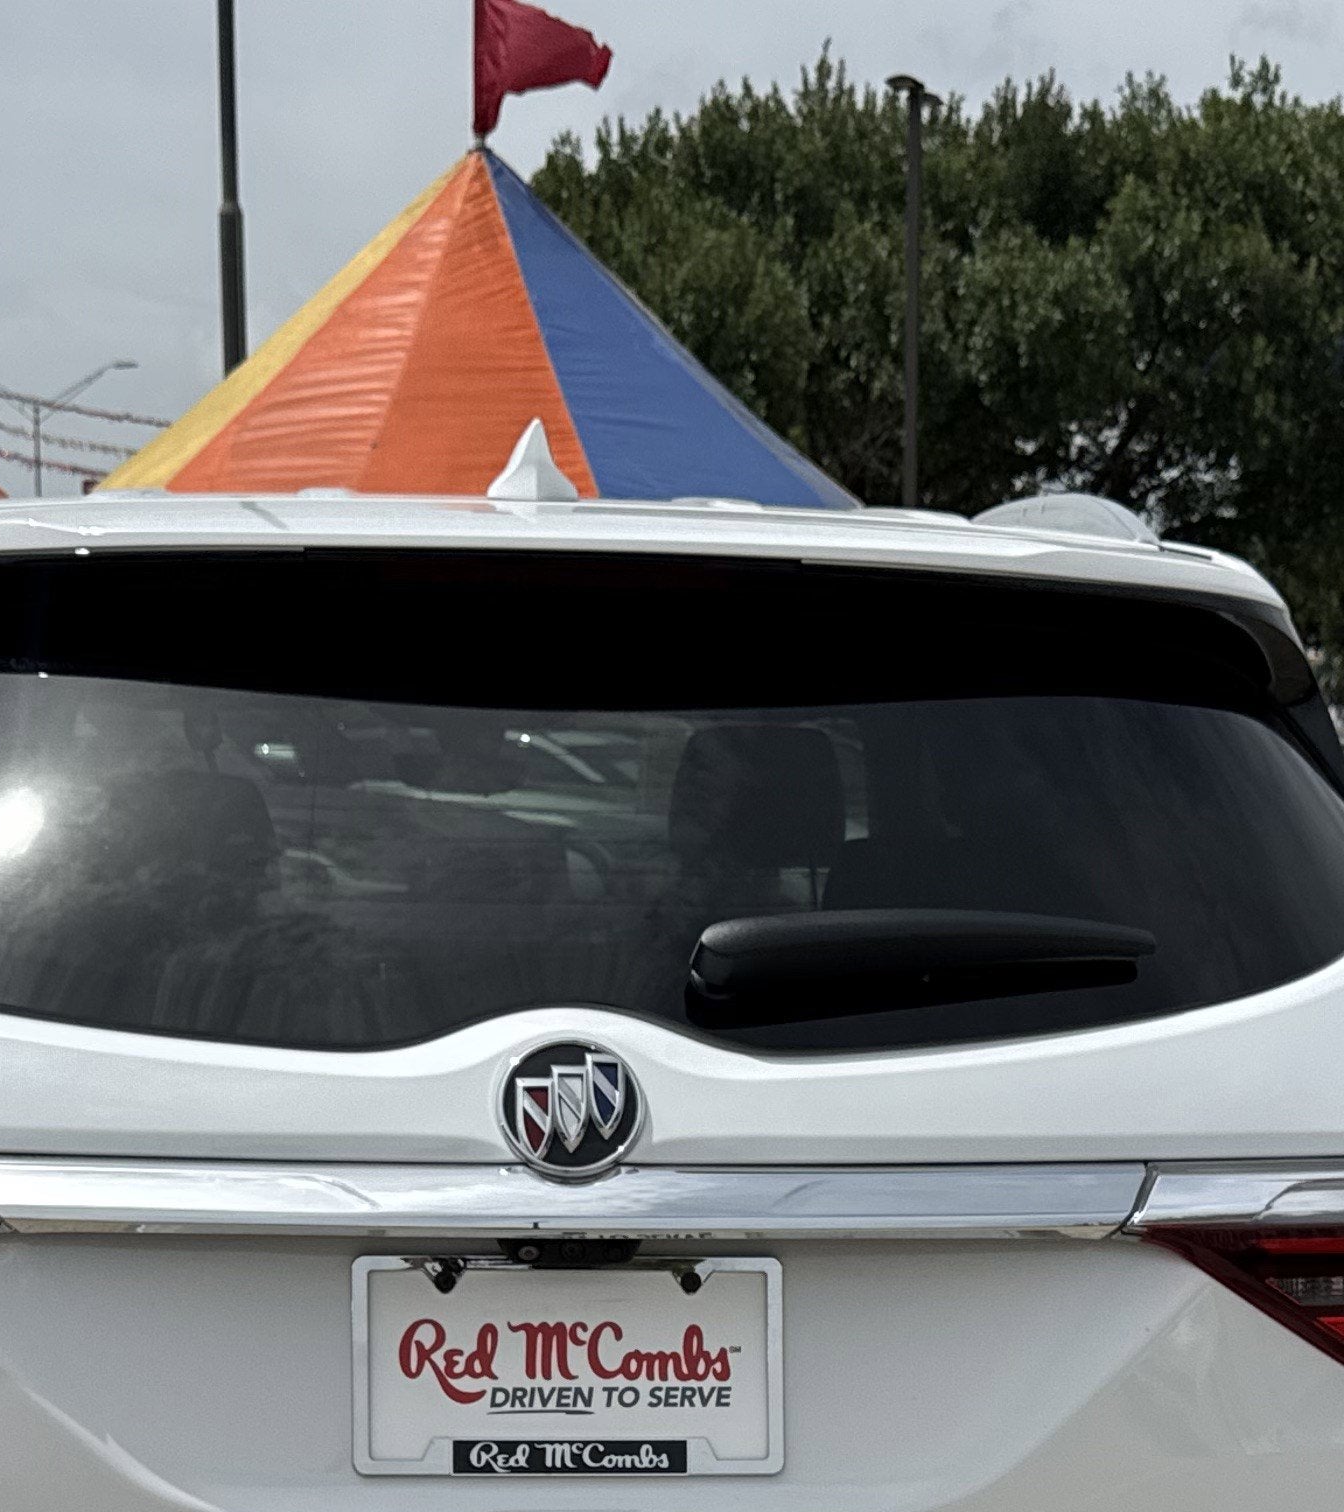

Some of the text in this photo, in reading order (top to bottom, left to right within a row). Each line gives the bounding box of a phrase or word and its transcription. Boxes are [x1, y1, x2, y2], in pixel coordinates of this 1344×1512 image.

[398, 1318, 498, 1404] Red
[507, 1320, 732, 1383] McCombs
[489, 1386, 733, 1409] DRIVEN TO SERVE
[469, 1441, 670, 1473] Red McCombs
